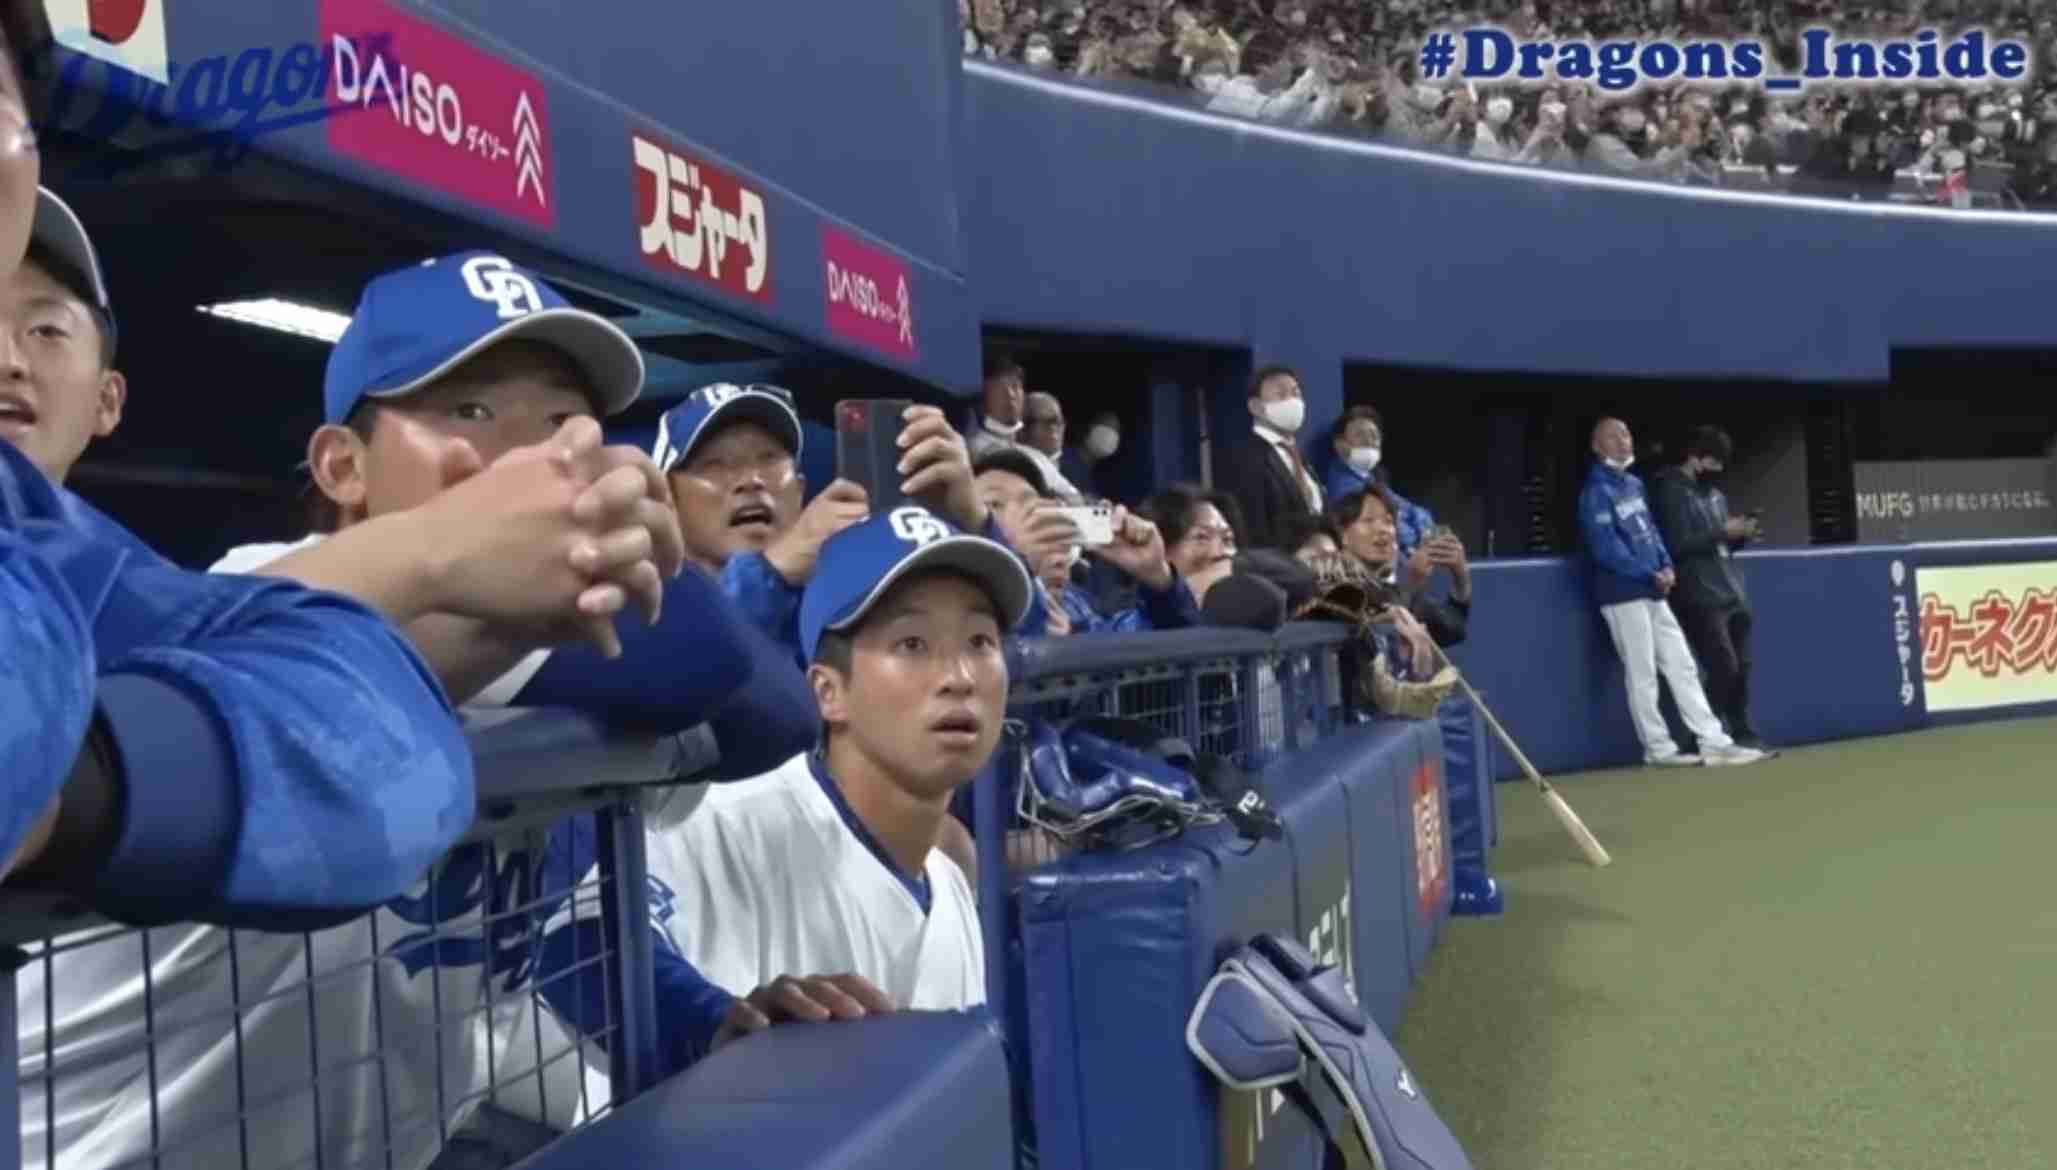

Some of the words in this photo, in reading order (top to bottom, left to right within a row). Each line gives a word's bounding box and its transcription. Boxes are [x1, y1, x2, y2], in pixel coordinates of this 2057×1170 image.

[333, 32, 462, 146] DAISO
[633, 136, 768, 293] スジャータ
[1856, 492, 1914, 518] MUFG
[1919, 592, 2057, 680] カーネク
